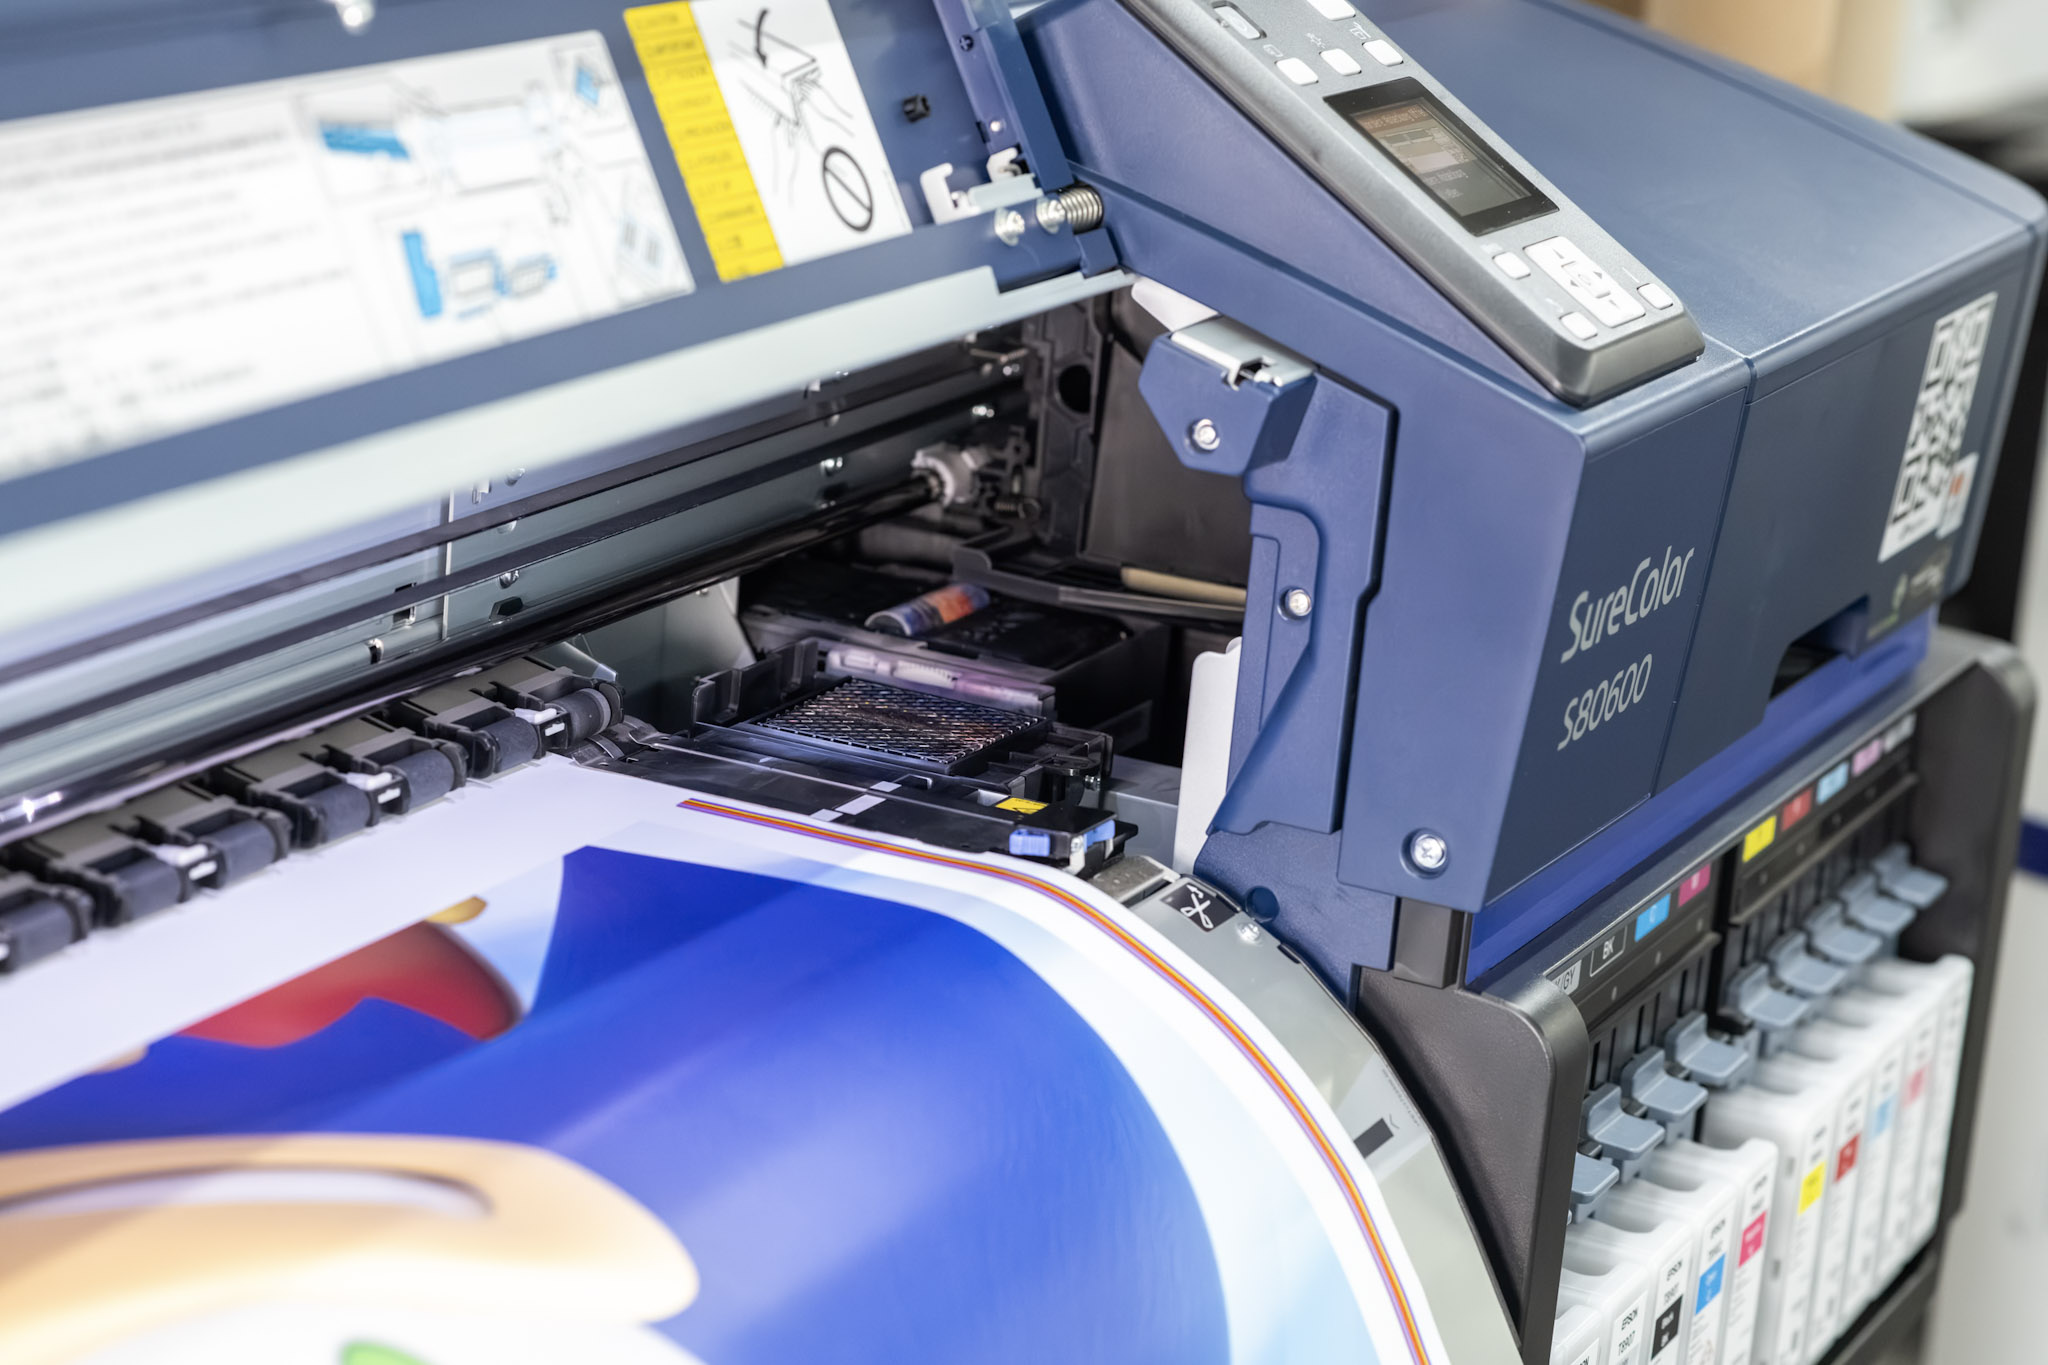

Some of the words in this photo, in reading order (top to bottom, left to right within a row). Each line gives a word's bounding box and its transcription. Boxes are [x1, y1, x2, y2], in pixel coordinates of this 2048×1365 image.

[1560, 545, 1695, 664] SureColor
[1557, 653, 1653, 751] S80600
[1602, 936, 1616, 960] BK
